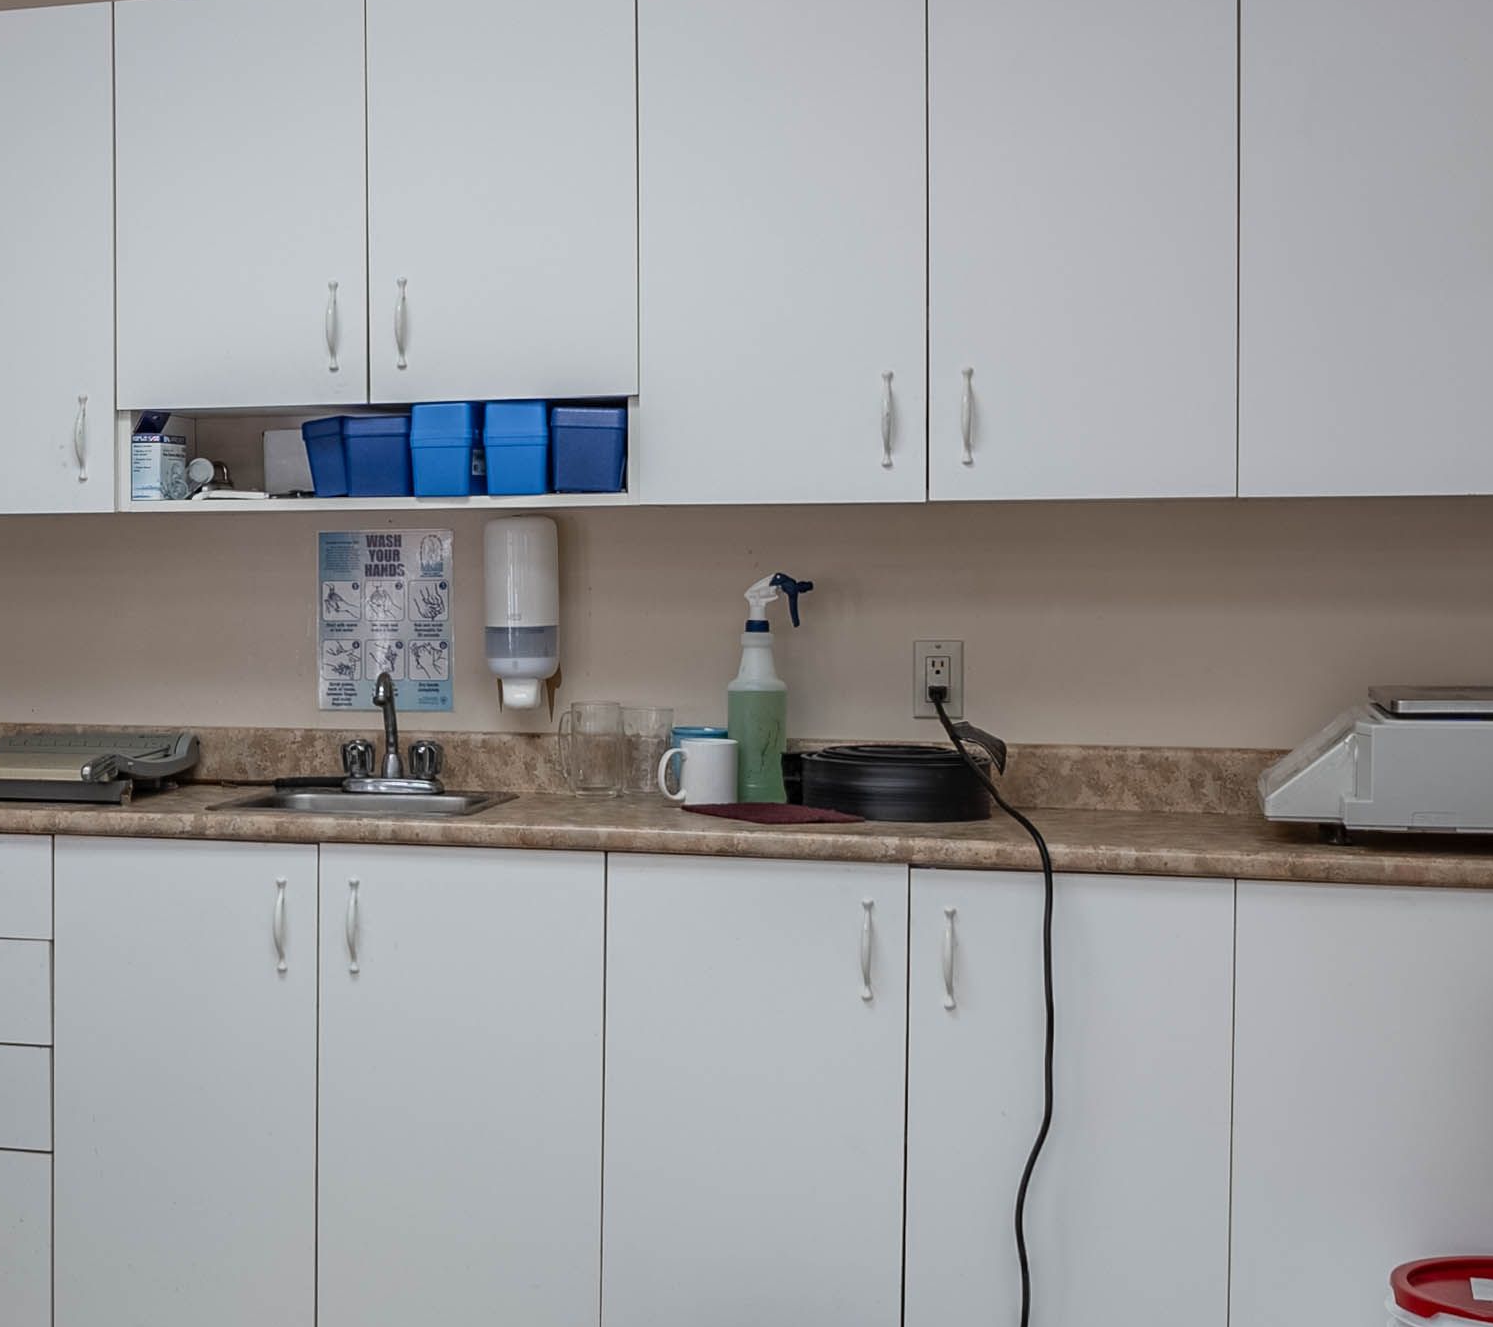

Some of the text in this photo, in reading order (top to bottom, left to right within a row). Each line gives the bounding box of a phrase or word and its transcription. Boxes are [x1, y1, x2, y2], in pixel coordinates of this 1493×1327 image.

[366, 535, 402, 548] WASH
[369, 549, 400, 563] YOUR
[365, 564, 405, 578] HANDS
